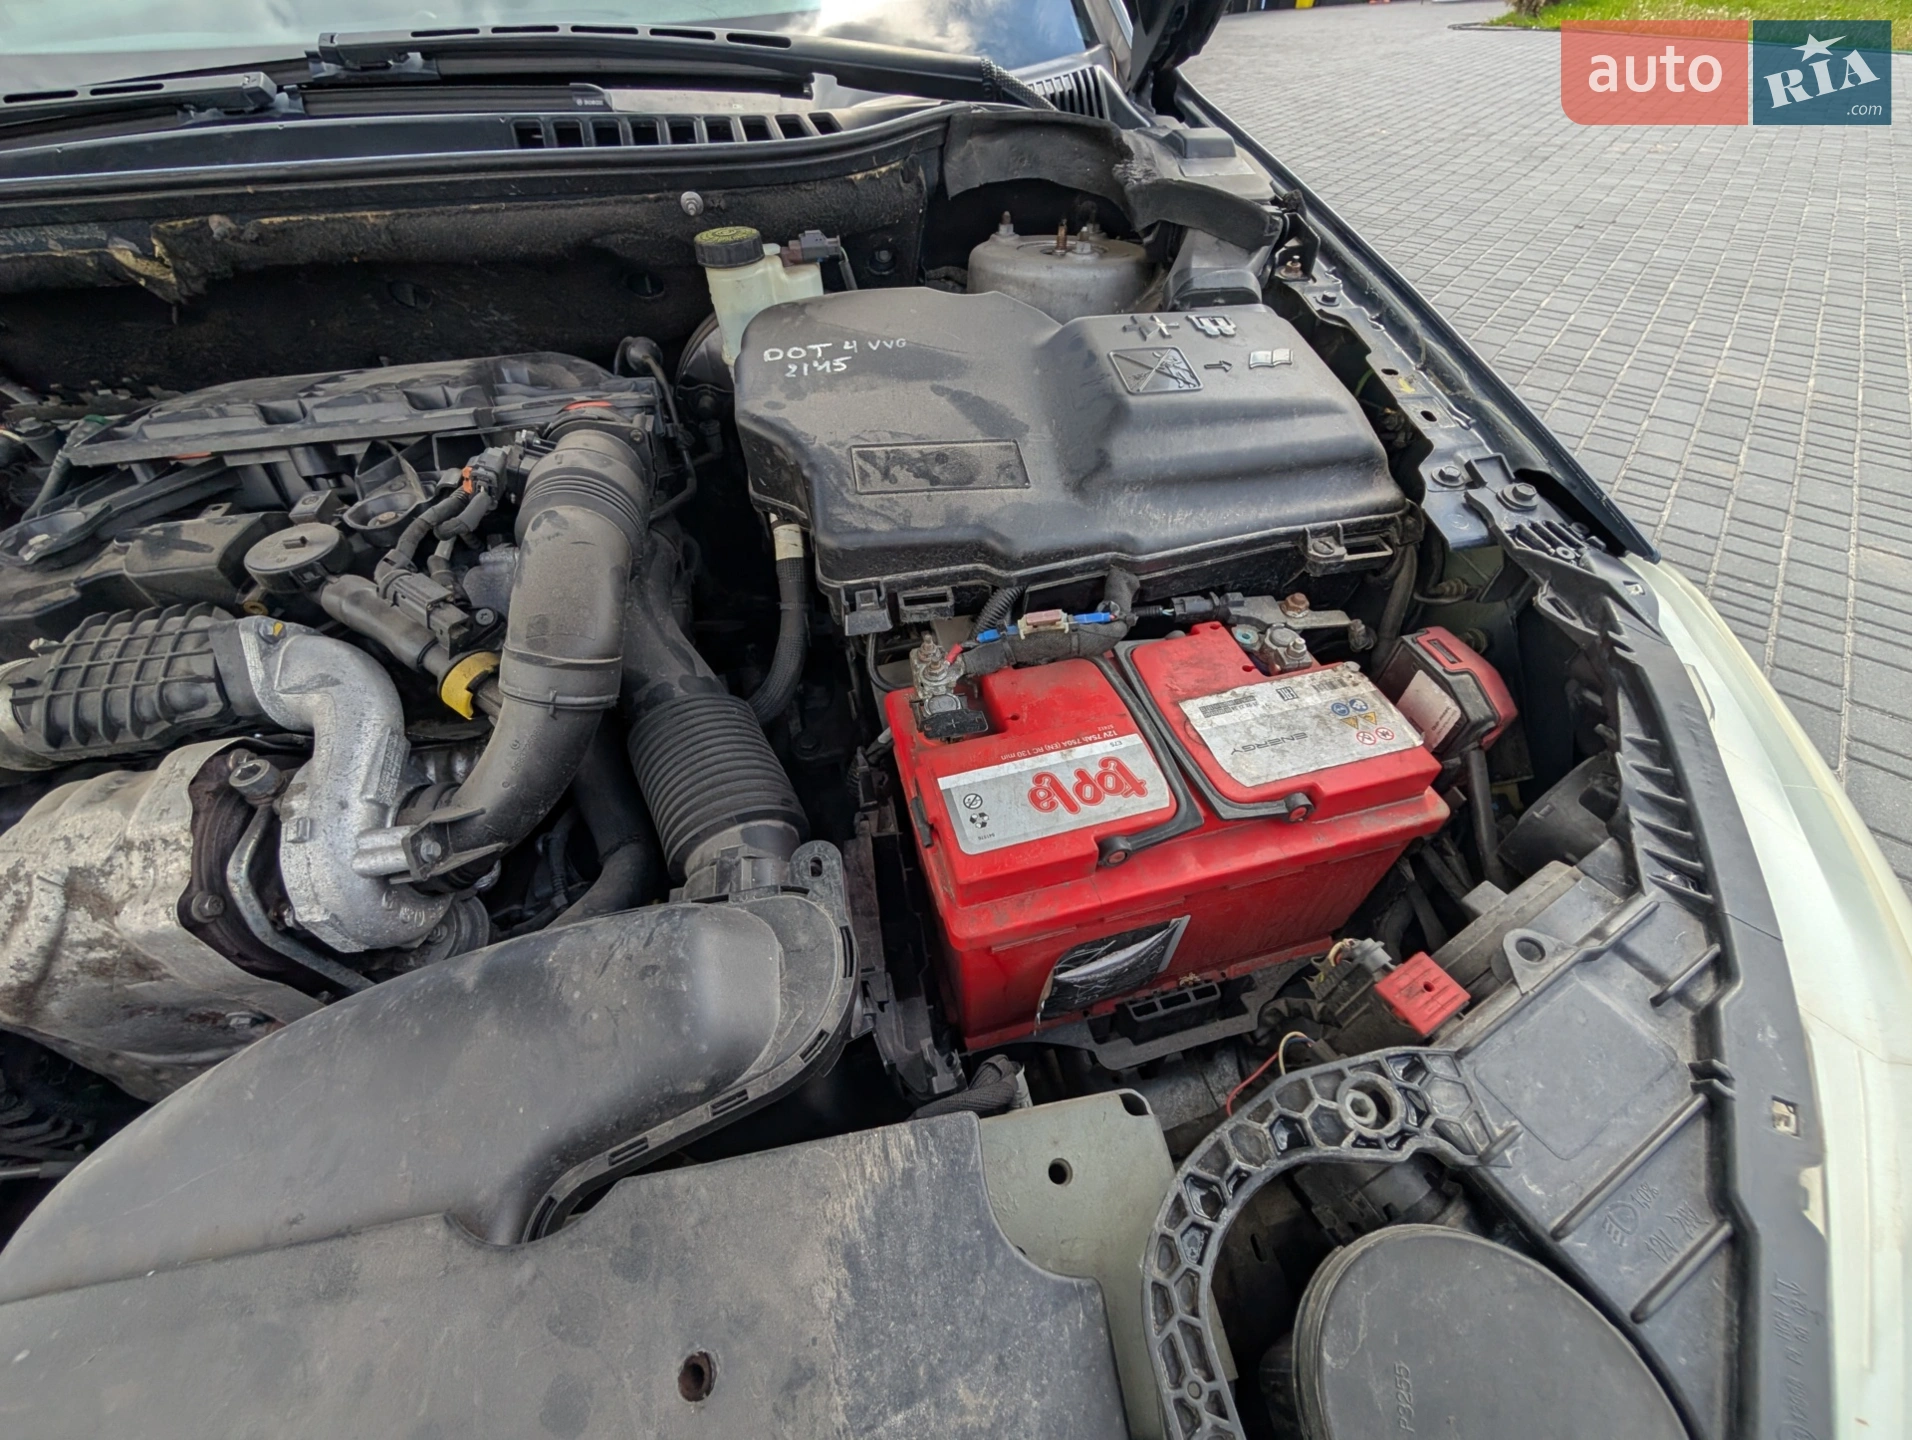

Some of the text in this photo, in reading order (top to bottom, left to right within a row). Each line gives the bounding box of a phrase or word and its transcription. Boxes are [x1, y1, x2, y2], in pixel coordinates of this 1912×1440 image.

[764, 342, 832, 362] DOT
[1103, 729, 1118, 738] 12V
[1231, 732, 1309, 755] ENERGY
[1017, 749, 1031, 758] 130
[1033, 745, 1044, 754] RC
[1027, 756, 1149, 815] topla
[1393, 1360, 1415, 1433] P3255
